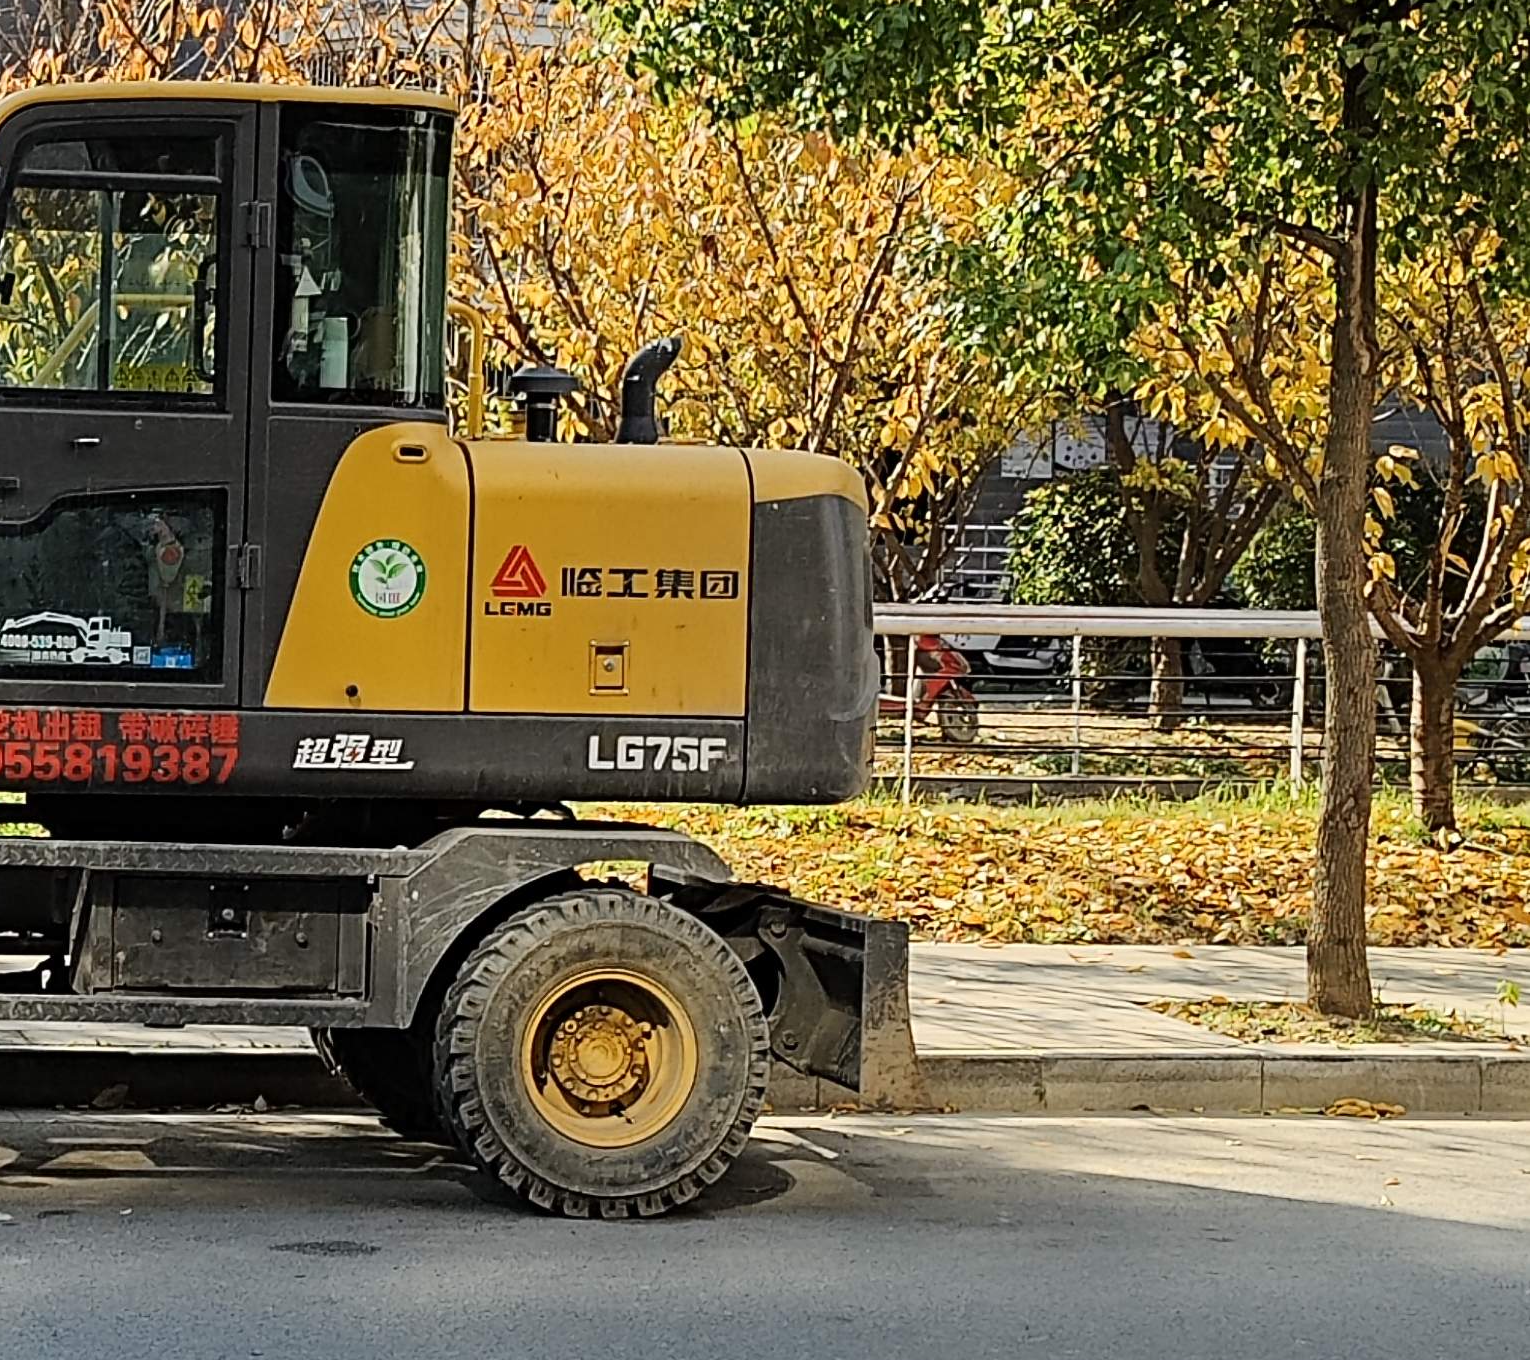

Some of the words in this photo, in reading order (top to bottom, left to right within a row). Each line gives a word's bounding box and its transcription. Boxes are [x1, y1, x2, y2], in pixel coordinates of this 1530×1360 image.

[561, 567, 739, 600] 临工集团
[484, 601, 552, 617] LGMG
[118, 712, 239, 744] 带破碎锤
[293, 733, 415, 771] 超强型
[588, 735, 728, 772] LG75F
